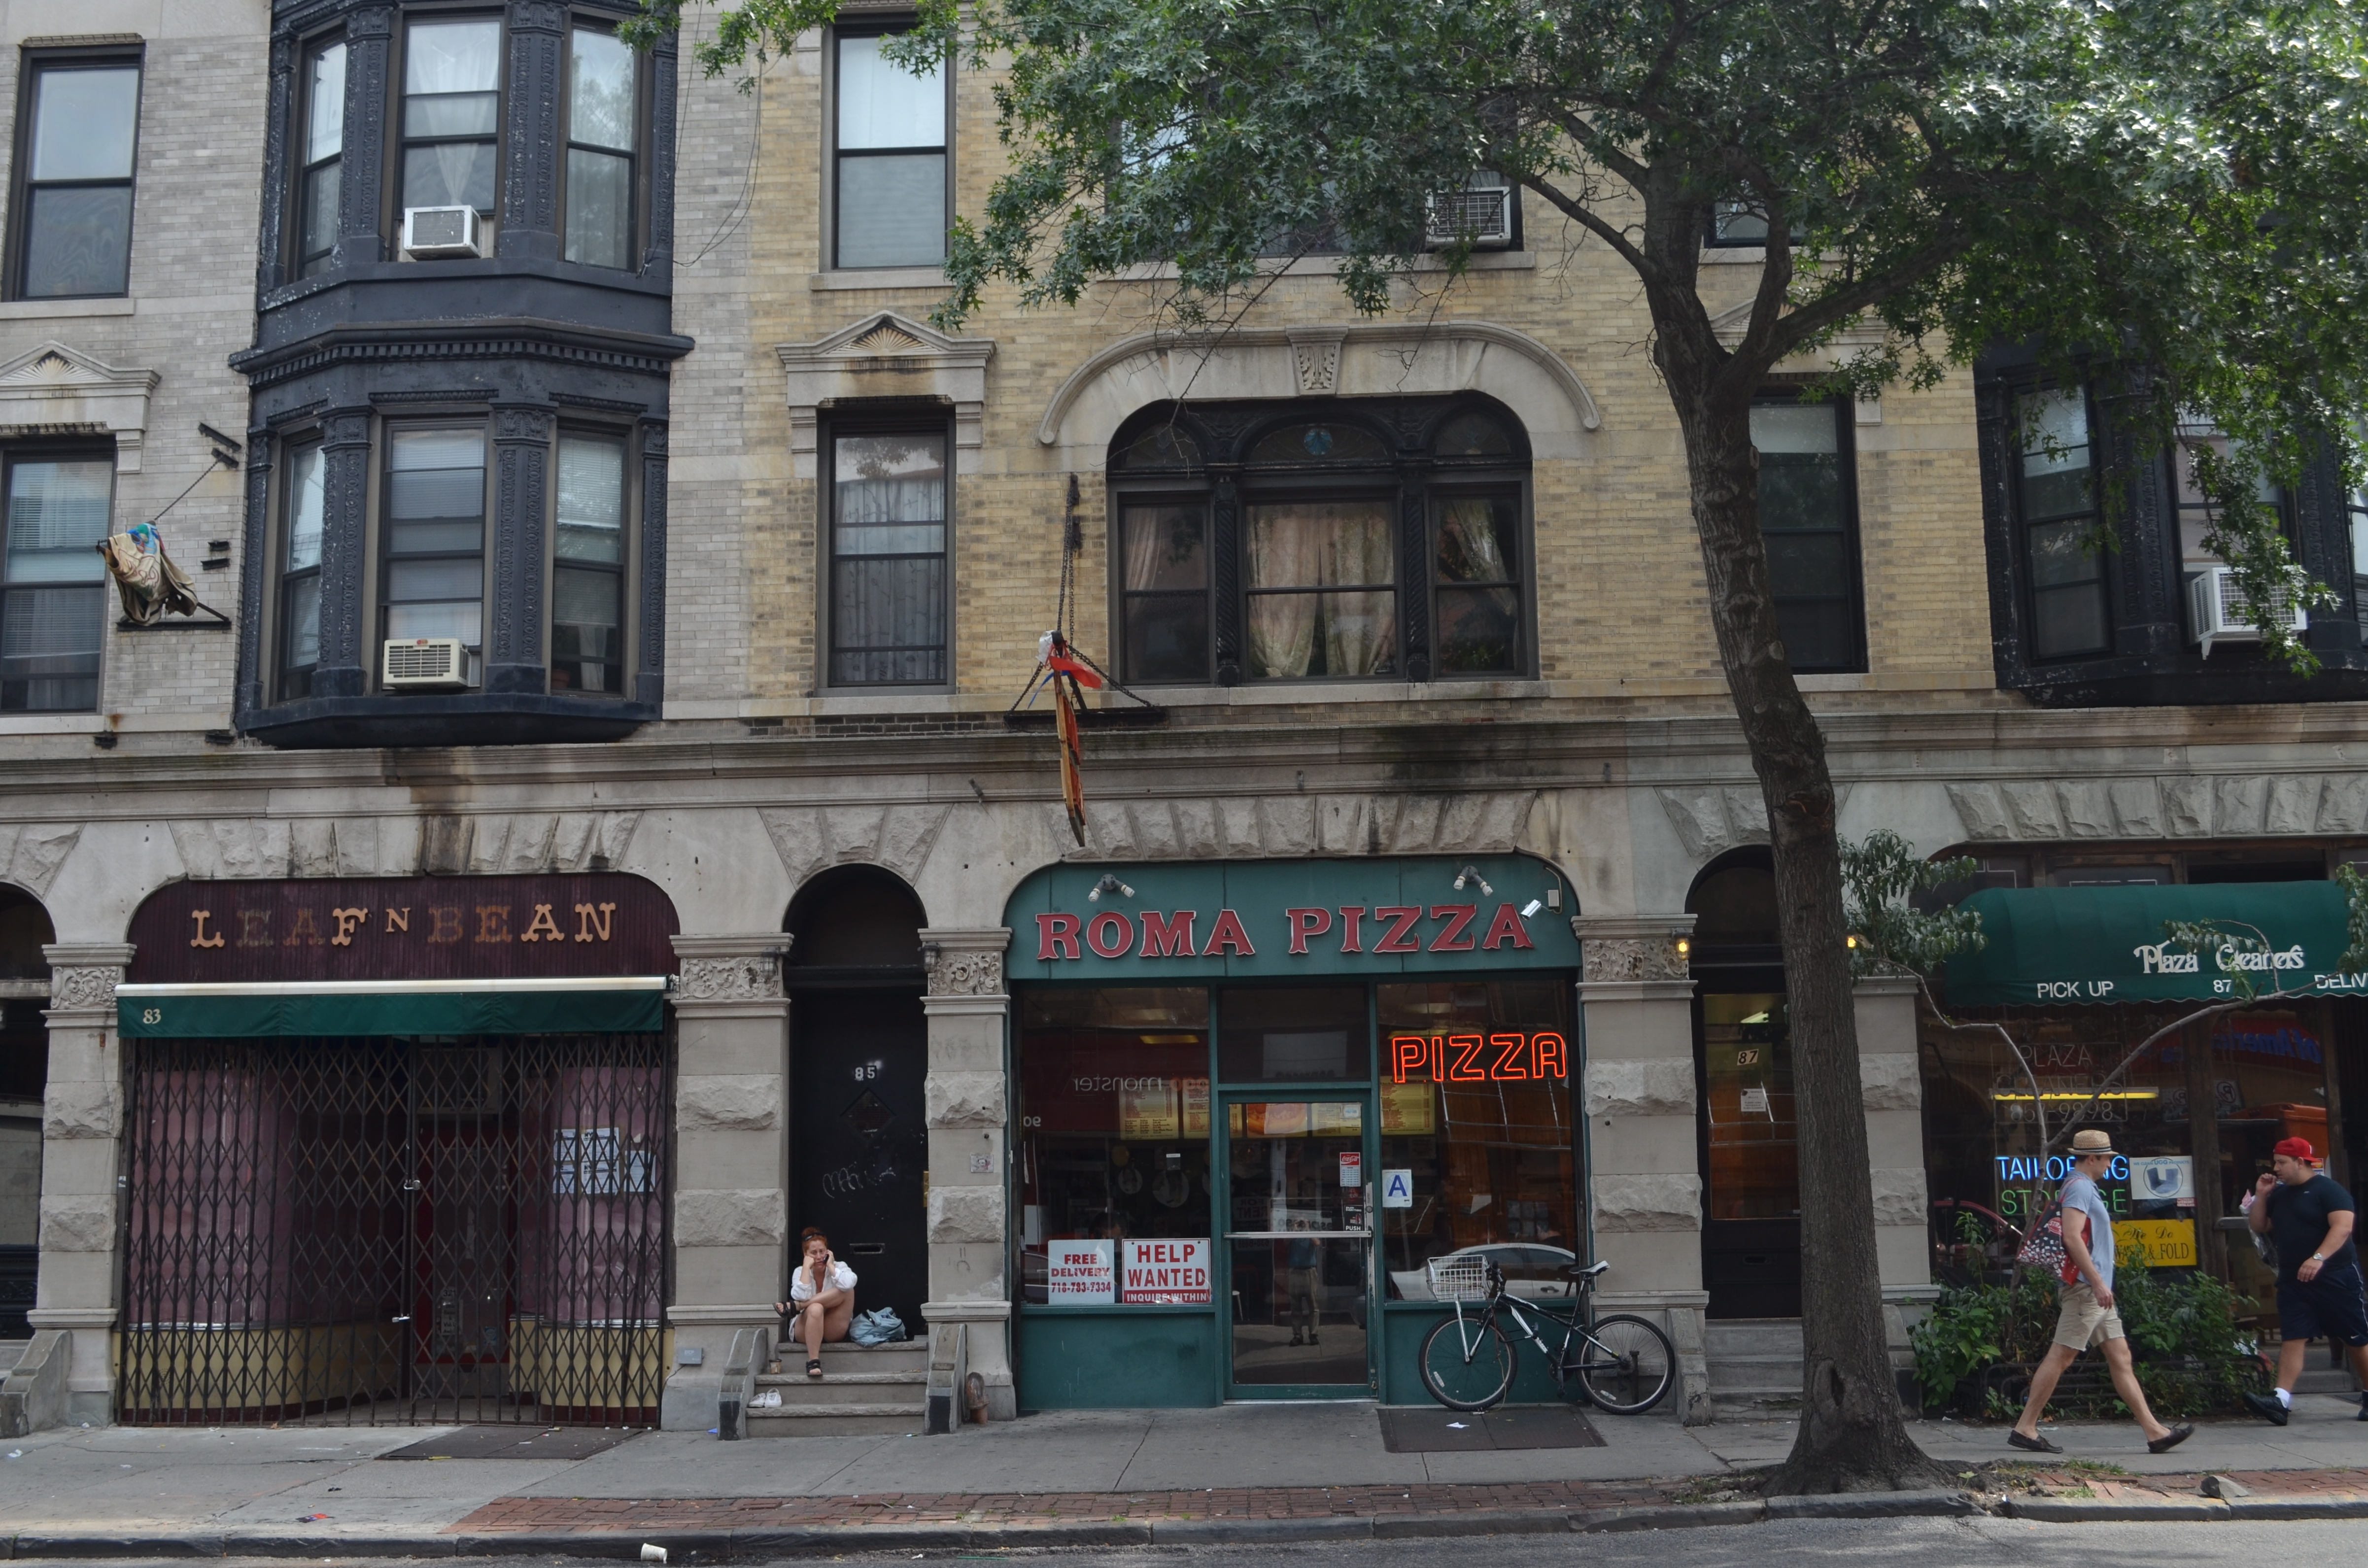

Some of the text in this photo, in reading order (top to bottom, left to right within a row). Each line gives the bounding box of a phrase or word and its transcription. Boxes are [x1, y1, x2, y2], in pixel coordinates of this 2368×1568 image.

[191, 902, 616, 948] LEAF N BEAN
[1034, 903, 1535, 961] ROMA PIZZA
[2133, 936, 2304, 974] Plaza Cleaners
[2212, 979, 2233, 993] 87
[2314, 972, 2368, 989] DELIV
[2037, 981, 2114, 999] PICK UP
[142, 1008, 162, 1024] 83
[1392, 1032, 1567, 1084] PIZZA
[1738, 1050, 1758, 1064] 87
[2018, 1044, 2093, 1067] PLAZA
[854, 1066, 876, 1080] 85
[1388, 1175, 1407, 1196] A
[2155, 1226, 2173, 1239] Do
[1064, 1254, 1097, 1264] FREE
[1137, 1244, 1195, 1263] HELP
[2148, 1243, 2155, 1260] &
[2160, 1242, 2189, 1260] FOLD
[1051, 1267, 1111, 1277] DELIVERY
[1128, 1268, 1205, 1287] WANTED
[1051, 1281, 1111, 1293] 718-783-7334
[1127, 1293, 1207, 1302] INQUIRE WITHIN
